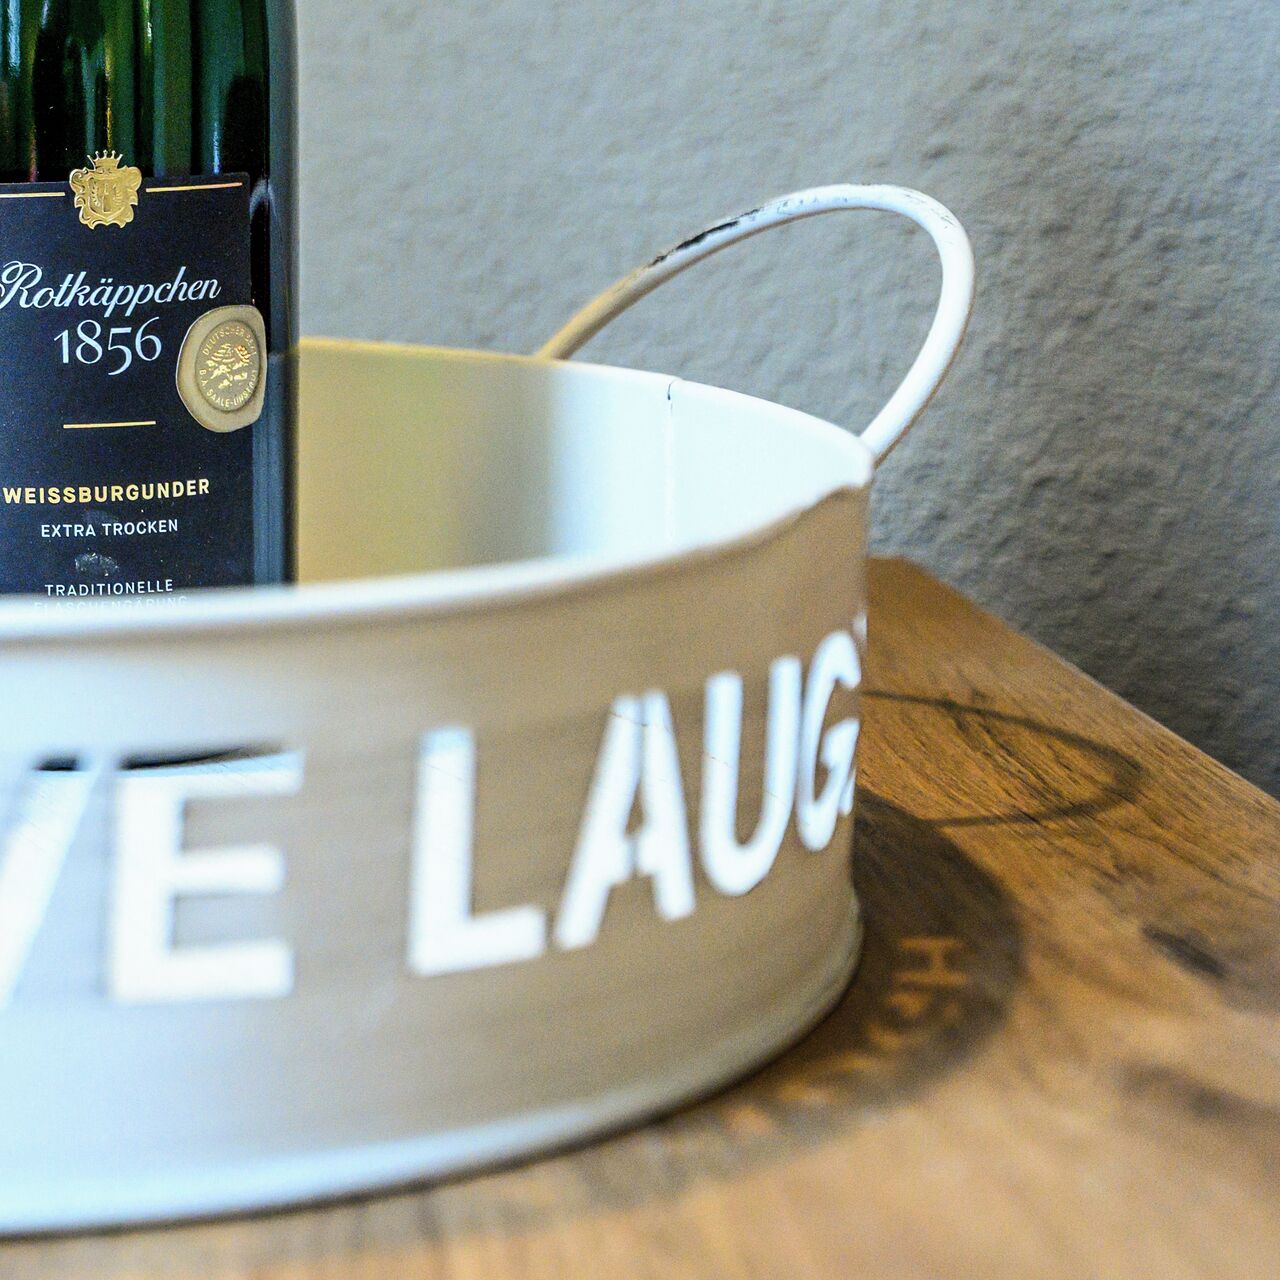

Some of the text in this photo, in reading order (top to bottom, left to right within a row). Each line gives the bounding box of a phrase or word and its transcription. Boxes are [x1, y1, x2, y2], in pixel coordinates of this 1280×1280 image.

[53, 317, 162, 376] 1856
[2, 478, 211, 505] WEISSBURGUNDER
[41, 518, 179, 538] EXTRA TROCKEN
[45, 579, 173, 597] TRADITIONELLE
[408, 615, 867, 977] LAUG
